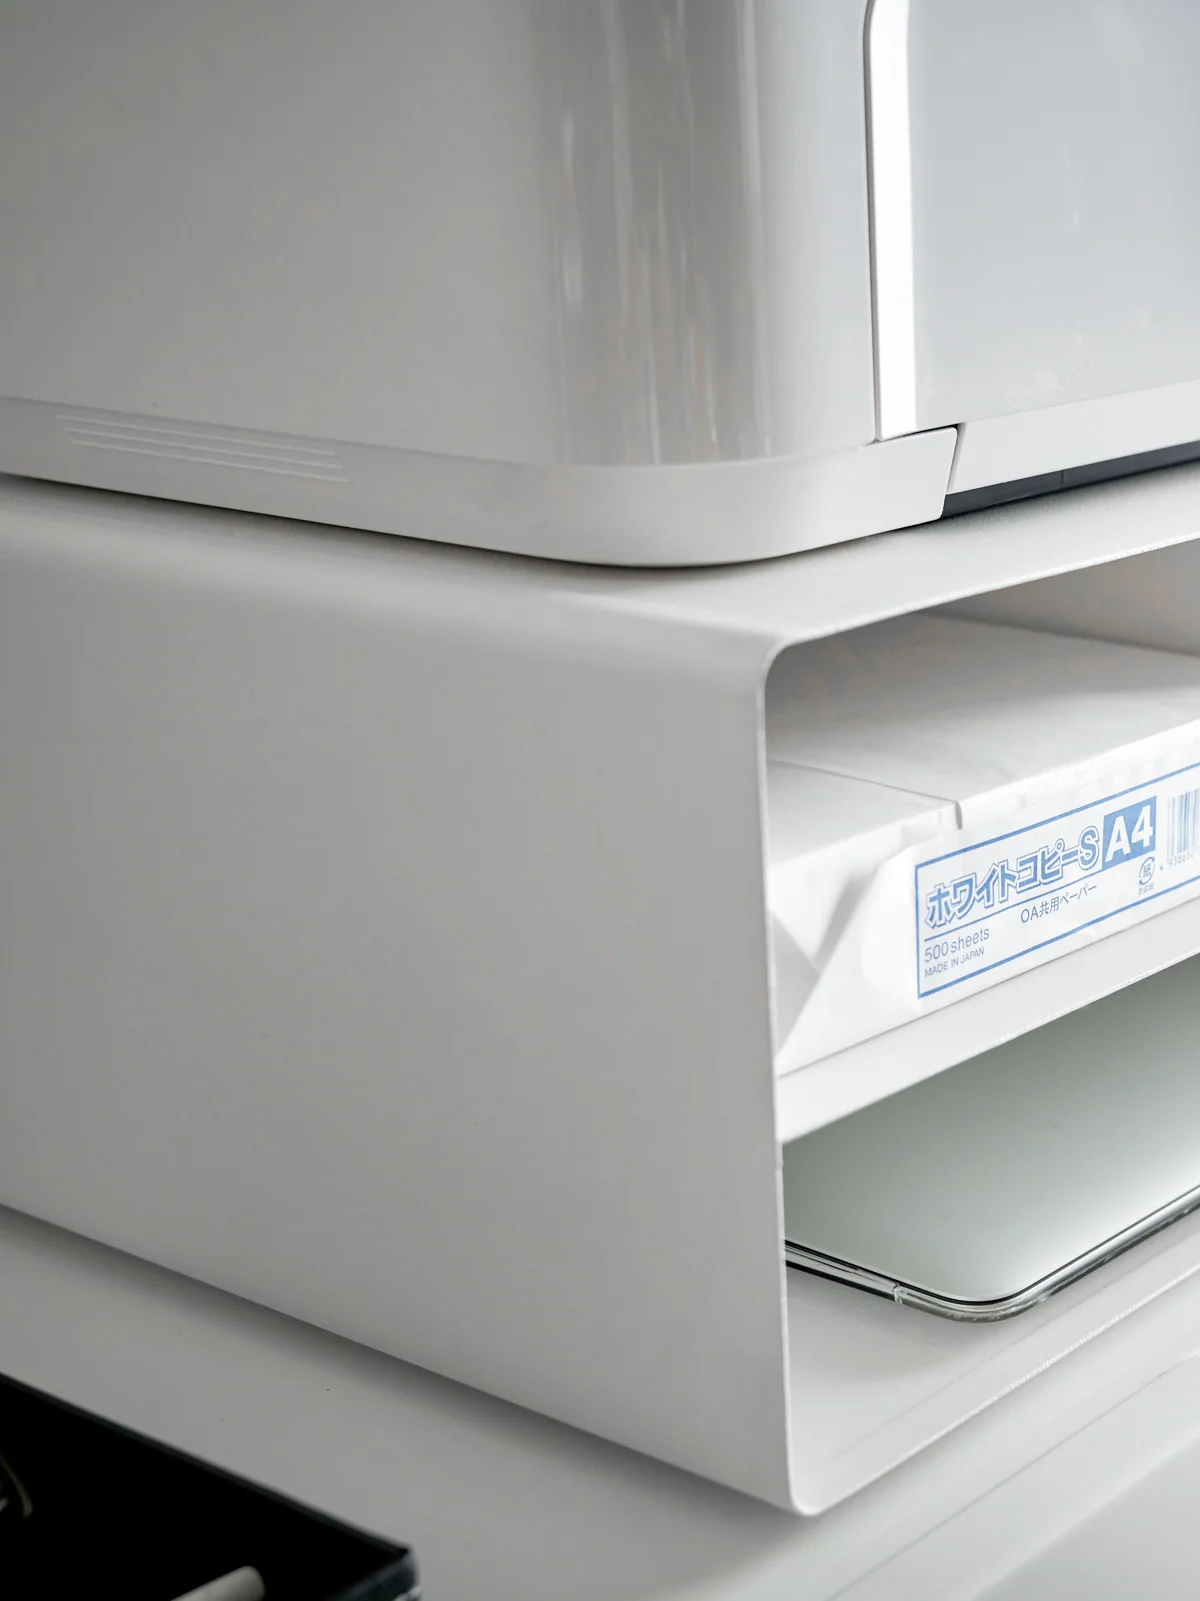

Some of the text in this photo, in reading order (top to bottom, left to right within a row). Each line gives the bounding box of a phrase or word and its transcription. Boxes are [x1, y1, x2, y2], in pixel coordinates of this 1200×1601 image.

[925, 825, 1100, 929] ホワイトコピーS
[1105, 805, 1154, 862] A4
[924, 947, 985, 978] MADE IN JAPAN
